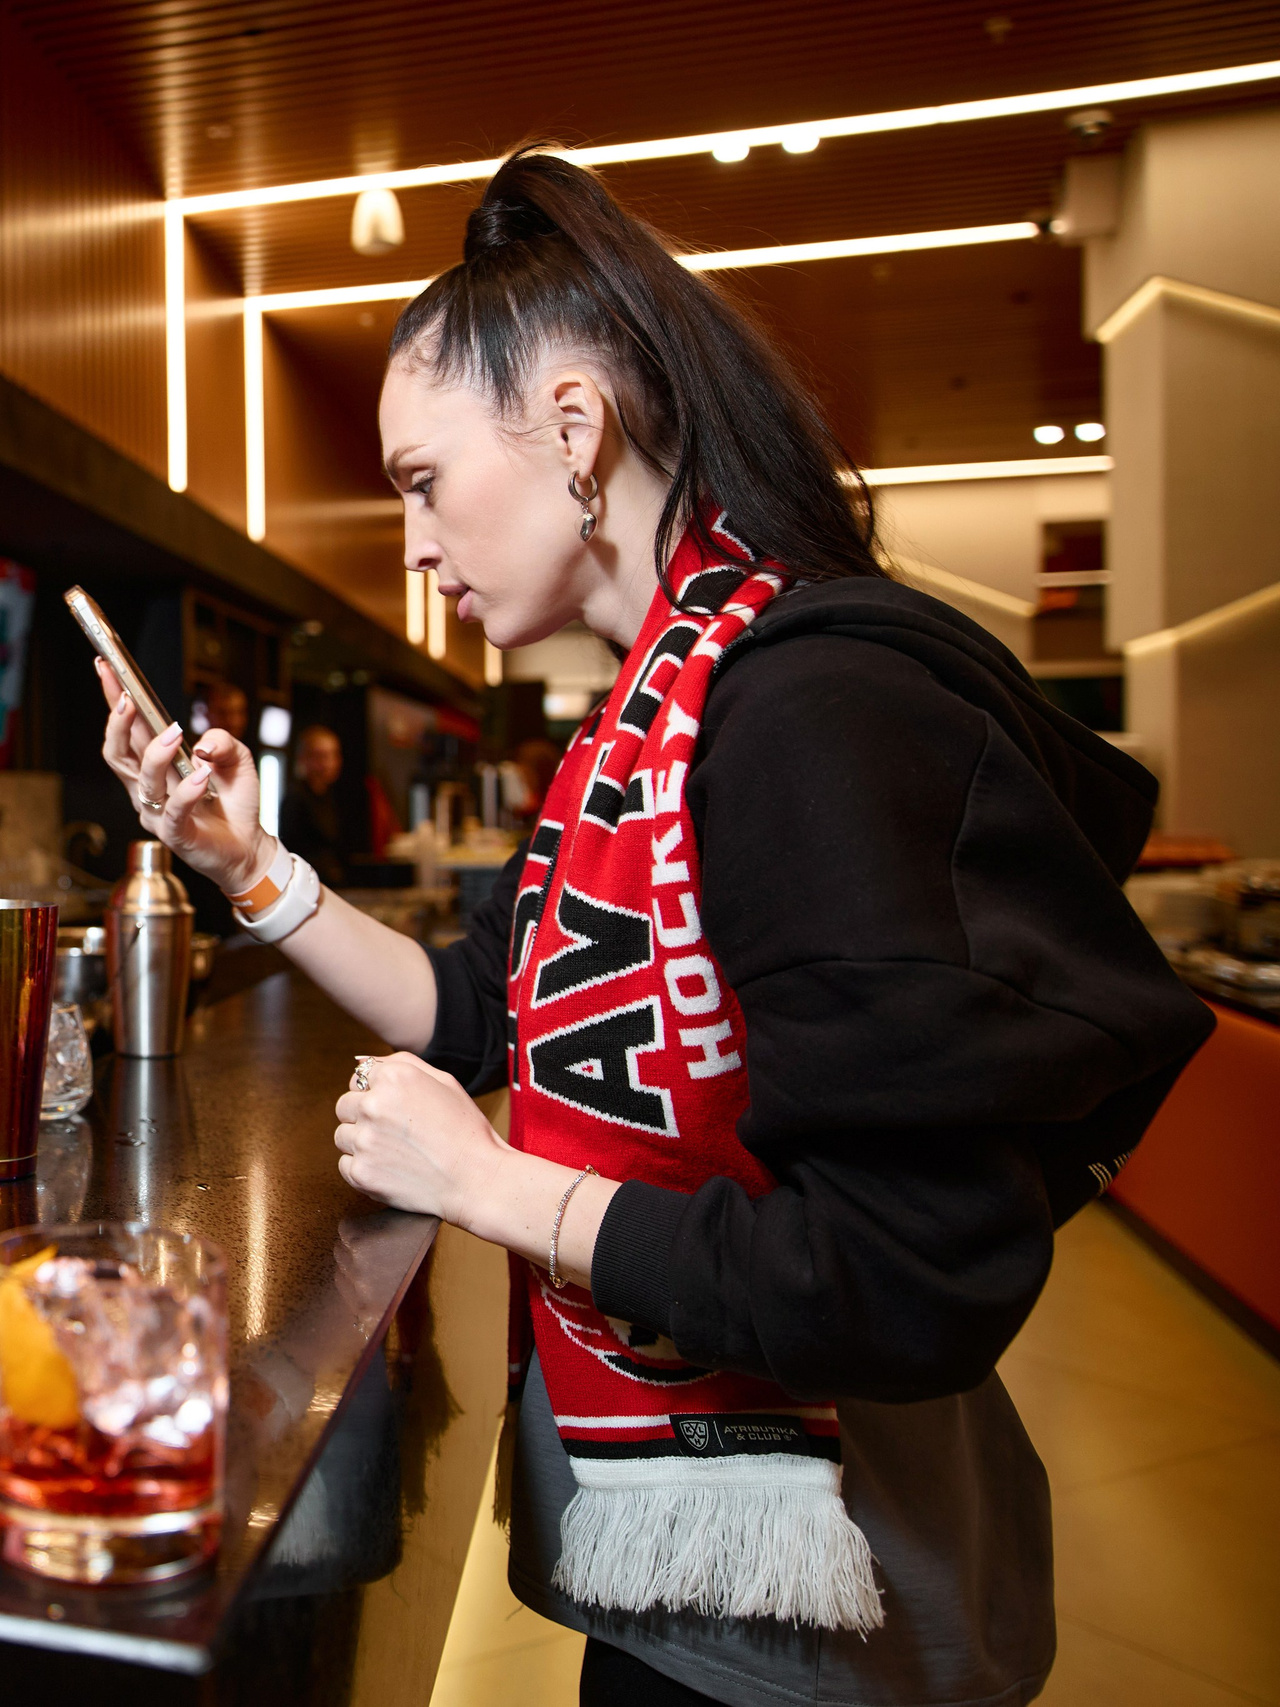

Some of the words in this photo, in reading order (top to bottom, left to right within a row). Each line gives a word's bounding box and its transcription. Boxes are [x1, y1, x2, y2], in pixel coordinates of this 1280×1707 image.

[651, 698, 742, 1080] HOCKEY
[724, 1425, 799, 1437] ATRIBUTIKA
[736, 1433, 746, 1441] &
[748, 1432, 782, 1441] CLUB
